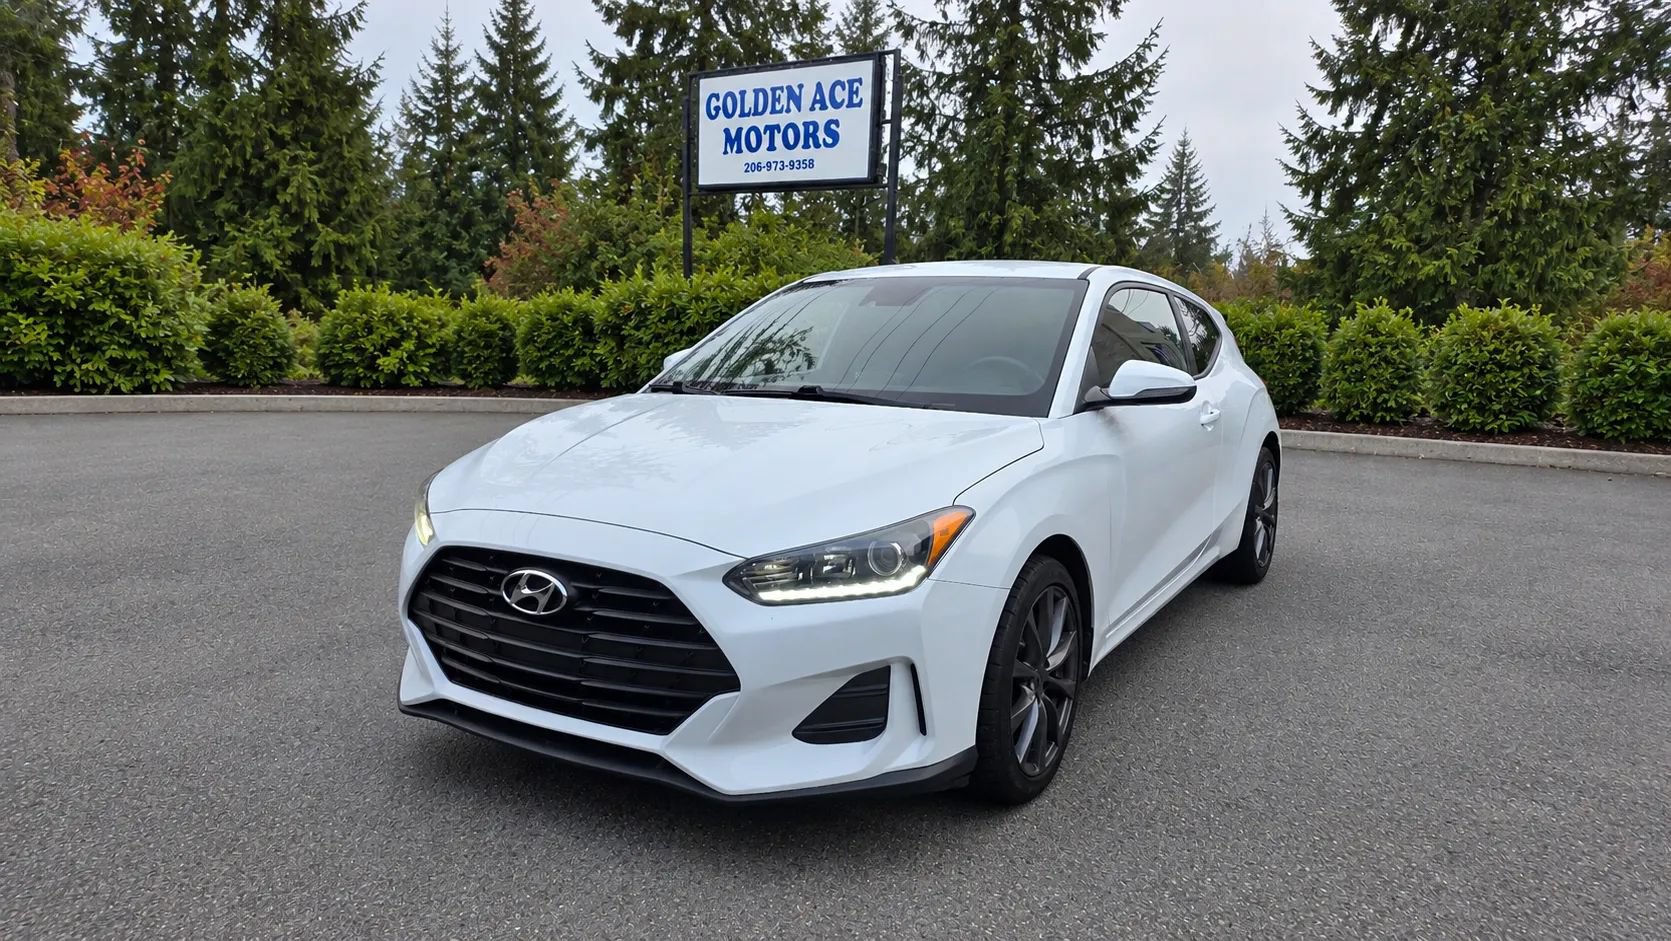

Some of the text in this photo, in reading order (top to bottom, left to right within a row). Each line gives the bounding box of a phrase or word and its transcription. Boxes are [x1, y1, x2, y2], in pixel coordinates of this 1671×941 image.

[705, 77, 863, 121] GOLDEN ACE
[722, 118, 840, 155] MOTORS
[743, 158, 815, 173] 206-973-9358
